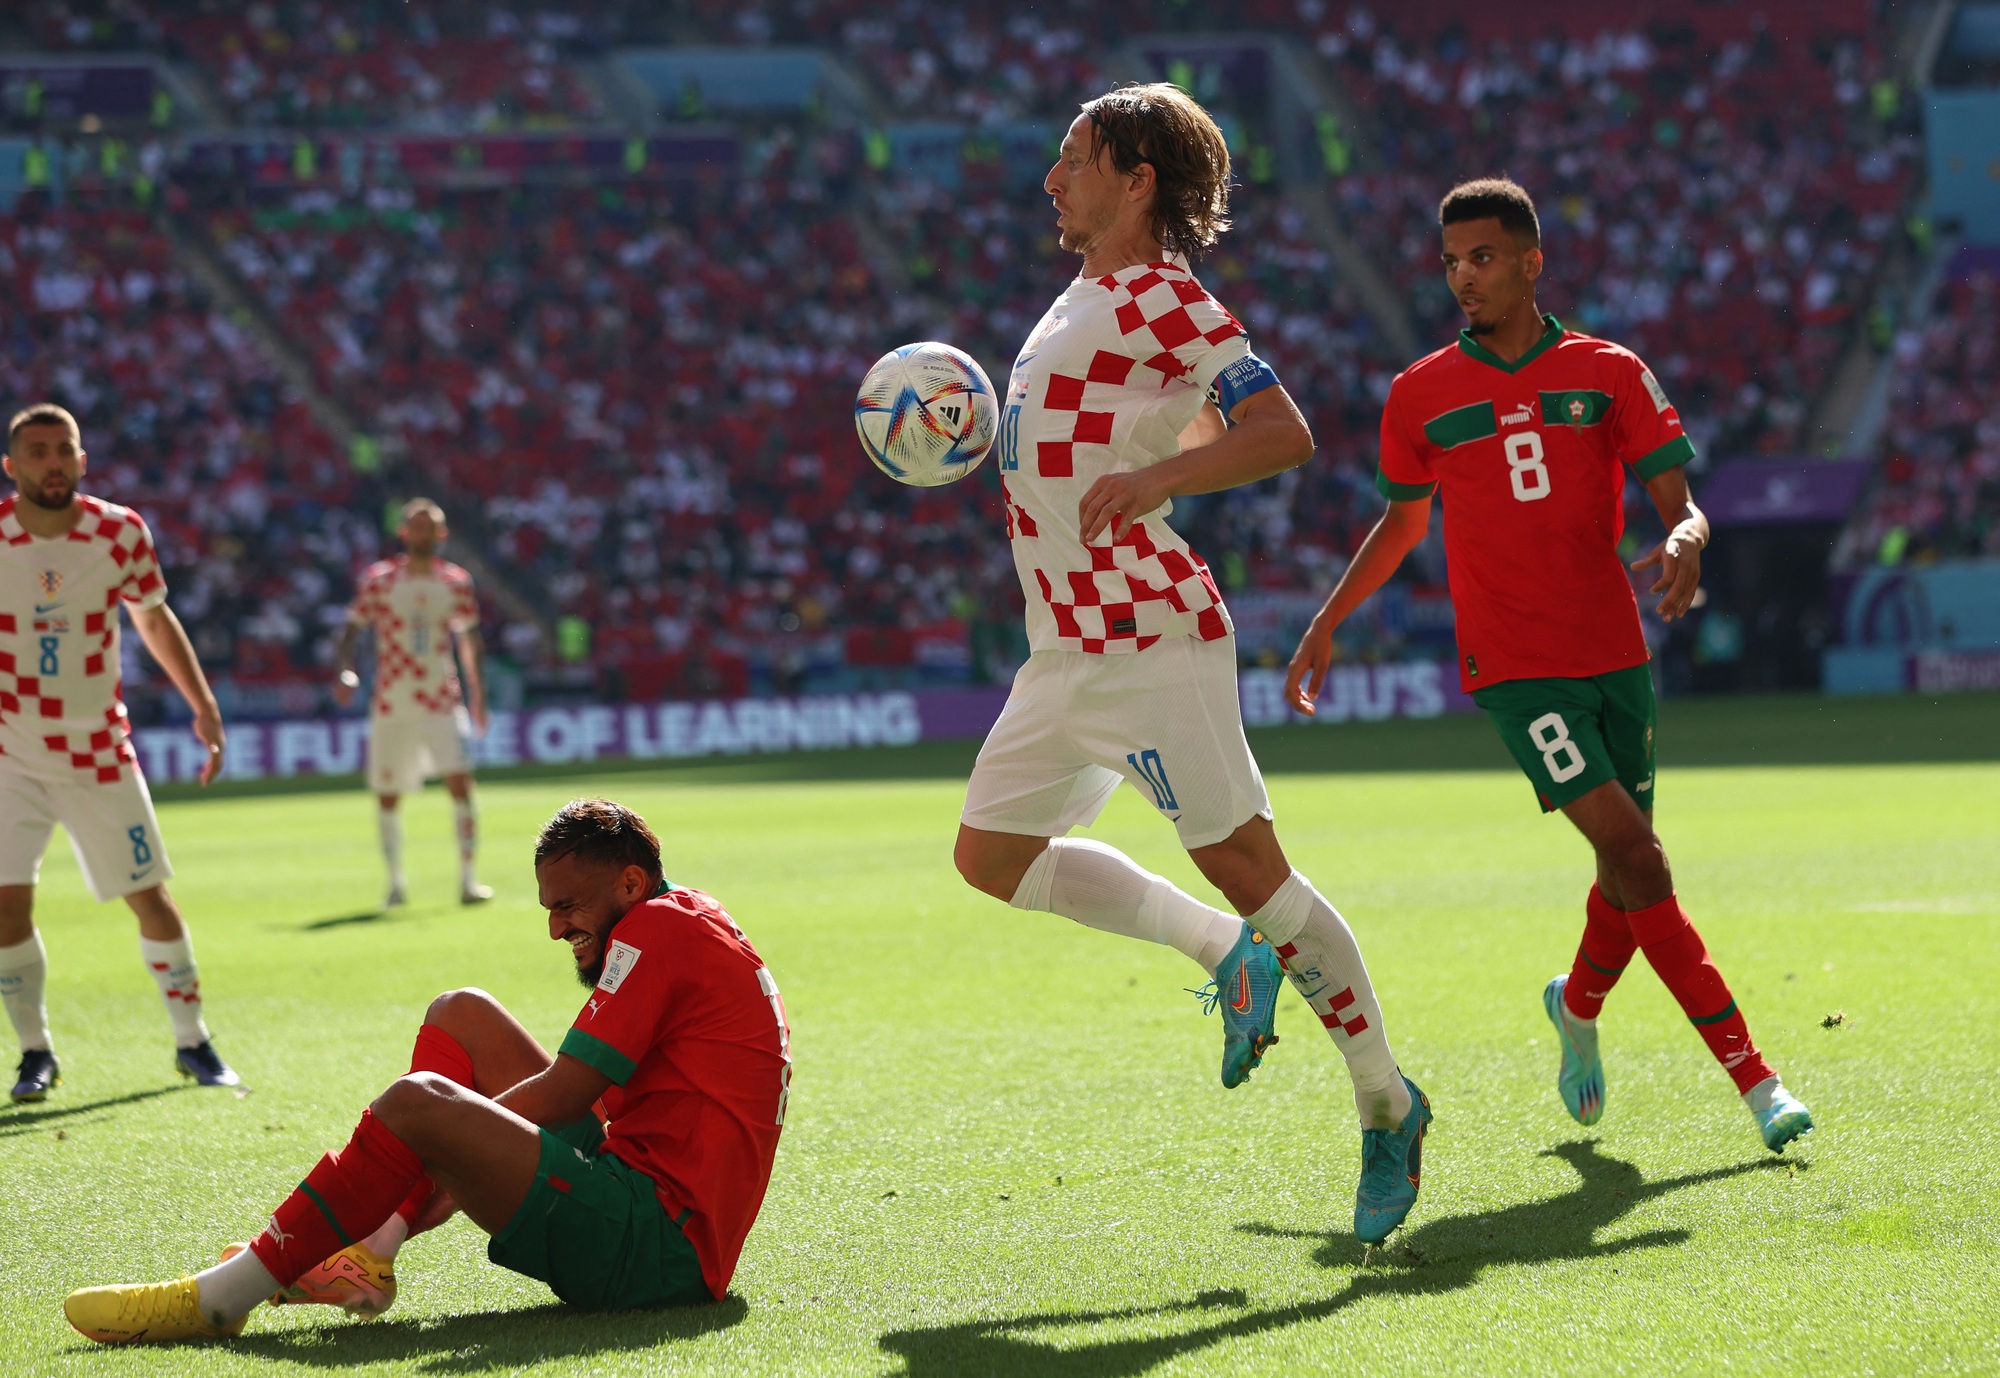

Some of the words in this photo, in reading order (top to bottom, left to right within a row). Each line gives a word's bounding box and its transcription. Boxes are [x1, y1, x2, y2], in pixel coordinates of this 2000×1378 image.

[1224, 360, 1256, 381] UNITES
[1231, 379, 1243, 389] the
[1242, 369, 1263, 383] World
[1500, 411, 1530, 427] PUMA
[1503, 430, 1552, 503] 8
[40, 636, 59, 677] 8
[1240, 660, 1446, 727] BJU'S
[140, 722, 264, 786] THE
[272, 711, 520, 777] FUE
[527, 704, 617, 765] OF
[624, 693, 921, 759] LEARNING
[1528, 712, 1586, 783] 8
[1127, 749, 1179, 810] 10
[128, 824, 152, 867] 8
